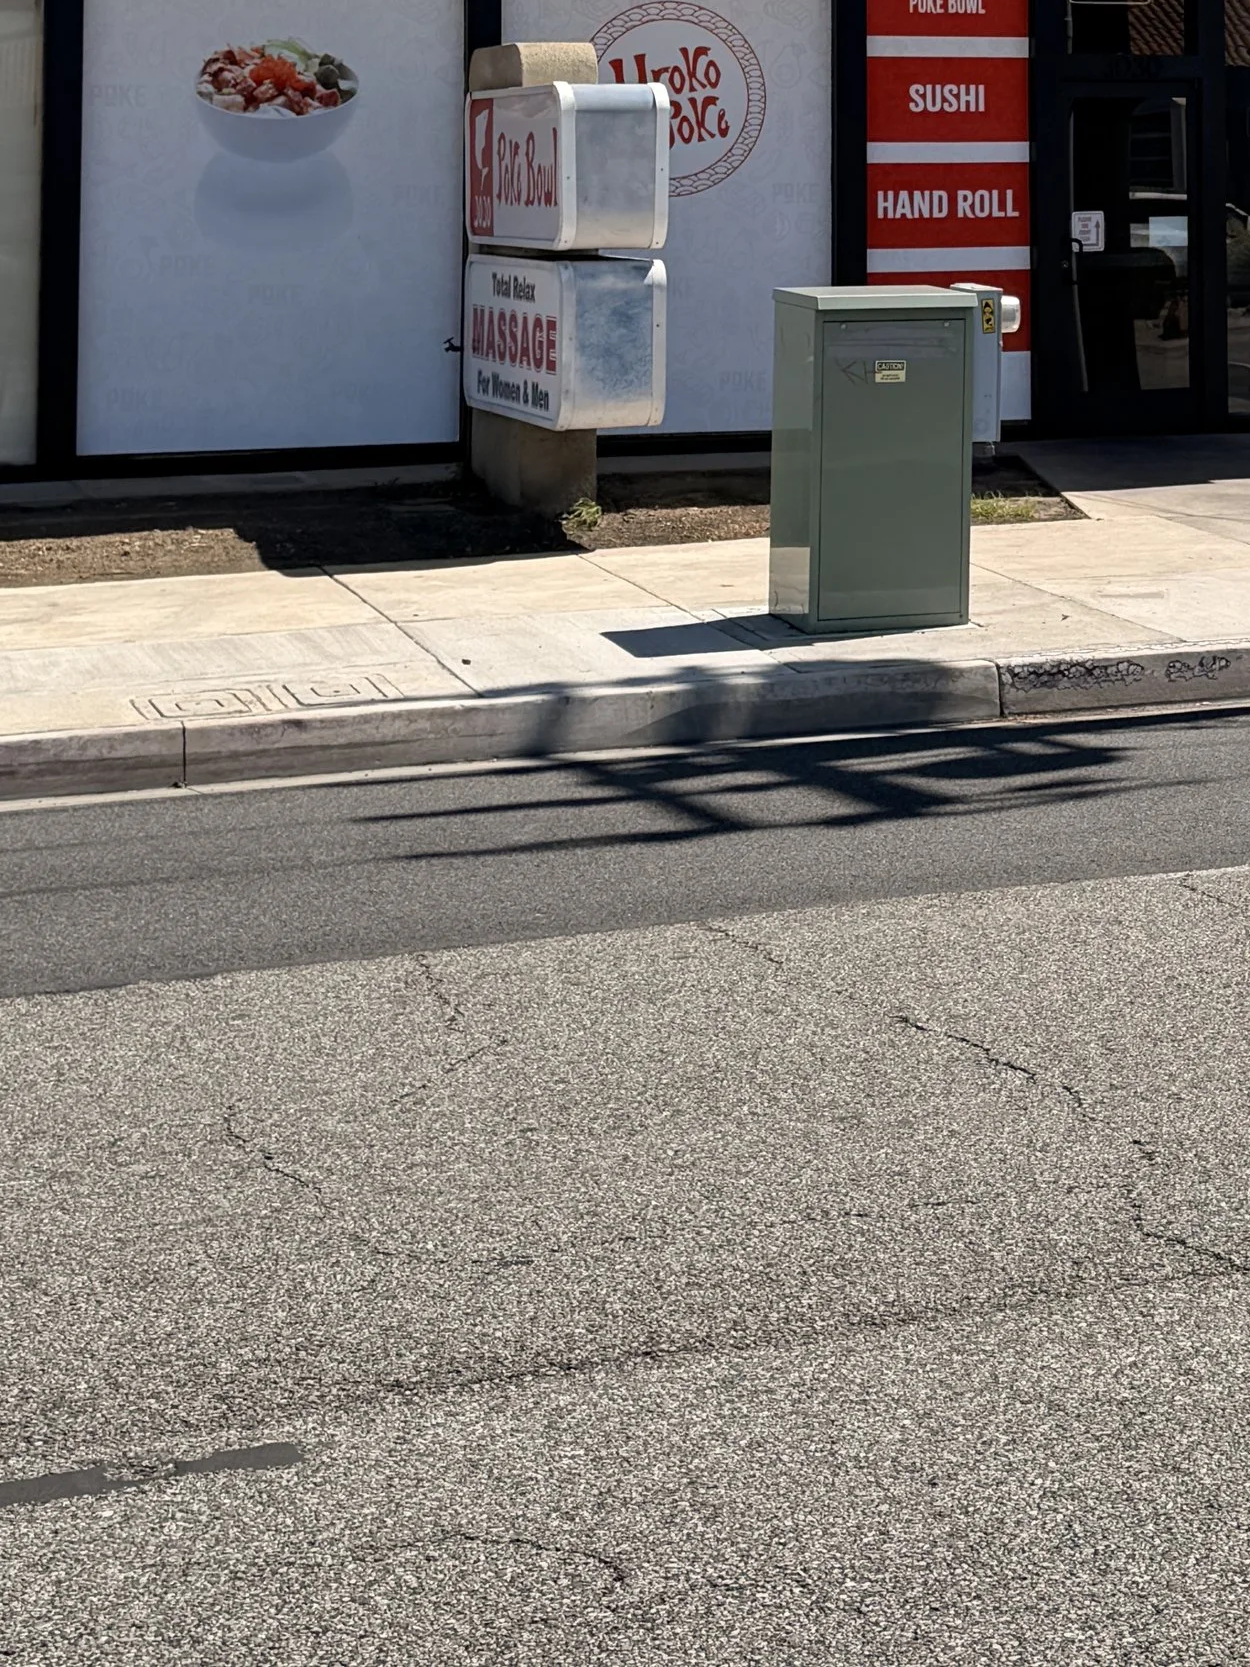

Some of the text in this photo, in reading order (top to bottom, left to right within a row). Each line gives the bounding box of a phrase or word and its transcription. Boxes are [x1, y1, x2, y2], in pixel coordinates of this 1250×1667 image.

[908, 83, 986, 113] SUSHI
[524, 126, 559, 207] Bowl
[876, 188, 1020, 220] HAND ROLL
[491, 271, 536, 303] Total Relax
[472, 304, 558, 376] MASSAGE
[477, 369, 550, 412] For Women & Men
